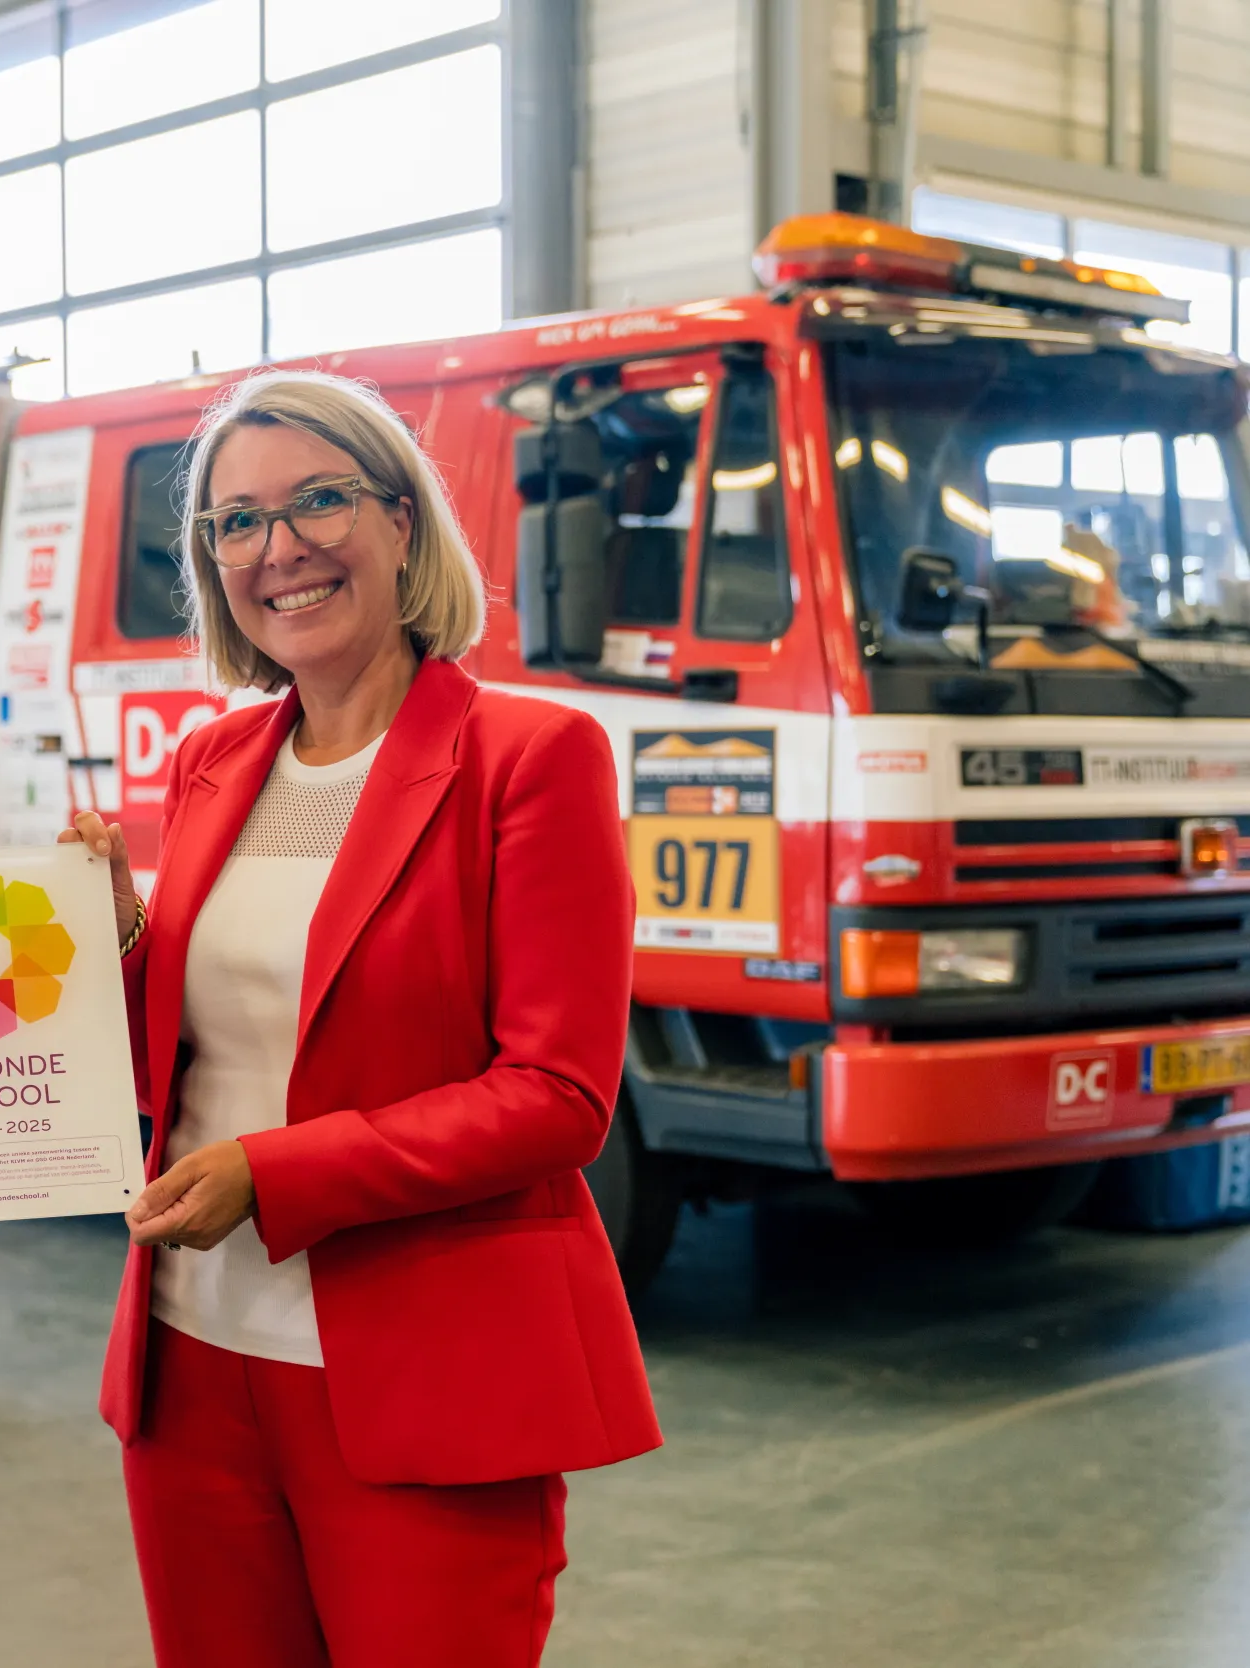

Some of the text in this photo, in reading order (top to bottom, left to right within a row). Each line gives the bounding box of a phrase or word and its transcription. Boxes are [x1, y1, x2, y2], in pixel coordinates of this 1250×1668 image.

[964, 750, 1029, 786] 45
[654, 838, 750, 909] 977
[31, 1148, 72, 1156] samenwerking
